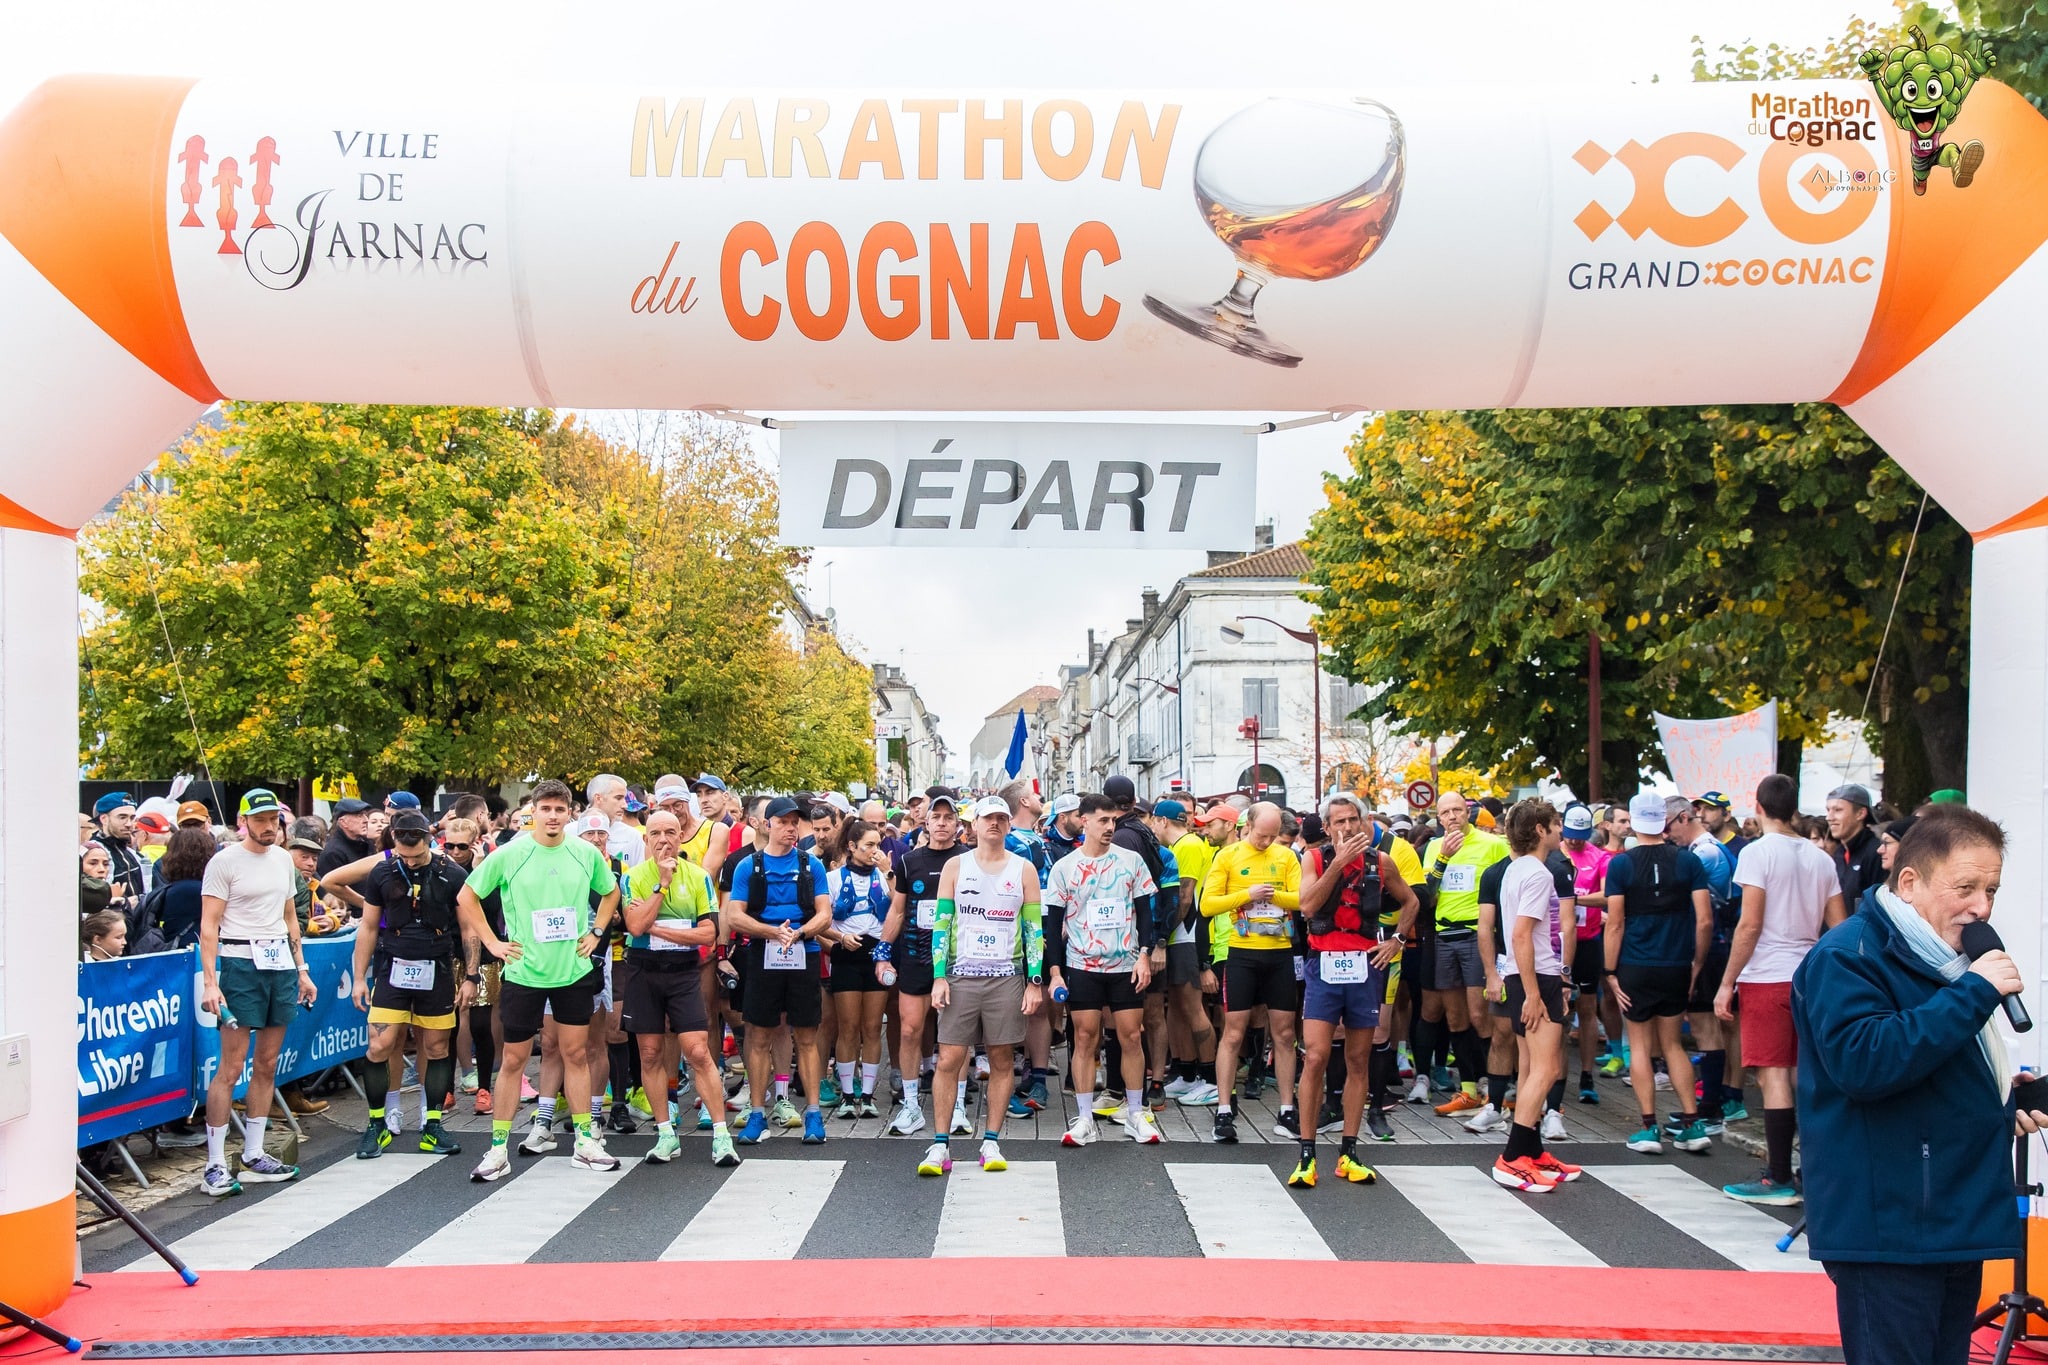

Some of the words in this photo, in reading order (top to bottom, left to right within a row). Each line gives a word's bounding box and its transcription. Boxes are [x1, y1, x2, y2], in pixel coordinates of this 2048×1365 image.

[333, 130, 440, 160] VILLE
[629, 96, 1183, 191] MARATHON
[358, 173, 404, 202] DE
[244, 188, 488, 290] JARNAC
[630, 240, 699, 314] du
[719, 220, 1122, 342] COGNAC
[1568, 261, 1700, 290] GRAND
[822, 438, 1222, 532] DÉPART
[1449, 872, 1464, 880] 163
[1097, 905, 1115, 915] 497
[546, 916, 566, 927] 362
[977, 935, 996, 945] 499
[776, 947, 794, 956] 45
[404, 967, 422, 976] 337
[1334, 959, 1354, 969] 663
